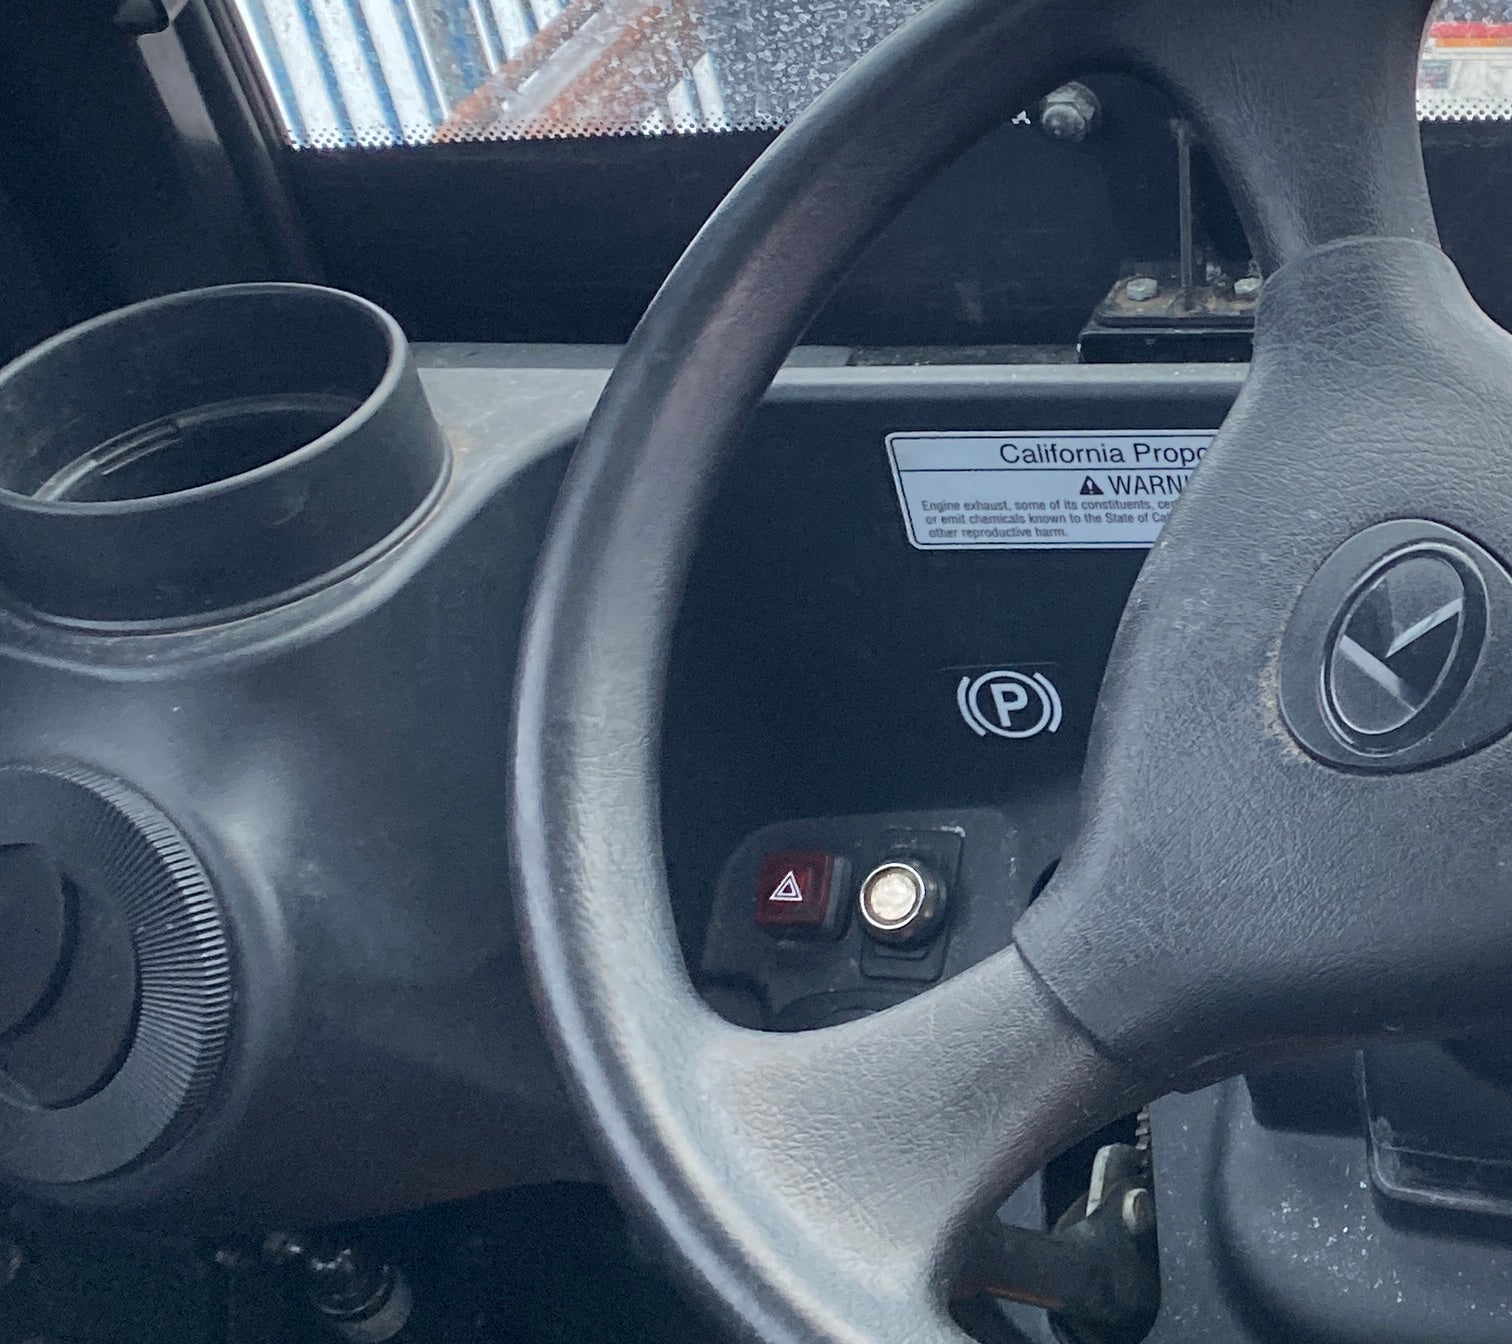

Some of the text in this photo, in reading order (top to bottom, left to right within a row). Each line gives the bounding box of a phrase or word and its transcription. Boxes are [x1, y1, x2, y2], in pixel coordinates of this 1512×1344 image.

[1000, 443, 1125, 464] California
[921, 500, 960, 513] Engine
[963, 500, 1012, 512] exhaust,
[1014, 501, 1047, 511] some
[1049, 499, 1061, 511] of
[1064, 499, 1079, 511] its
[1081, 498, 1155, 511] constituents,
[925, 515, 938, 525] or
[941, 513, 966, 525] emit
[969, 513, 1026, 525] chemicals
[1029, 512, 1067, 524] known
[1070, 512, 1081, 524] to
[1084, 511, 1103, 524] the
[1105, 511, 1134, 524] State
[1138, 511, 1150, 523] of
[928, 525, 1068, 539] other reproductive harm.
[990, 683, 1028, 727] P
